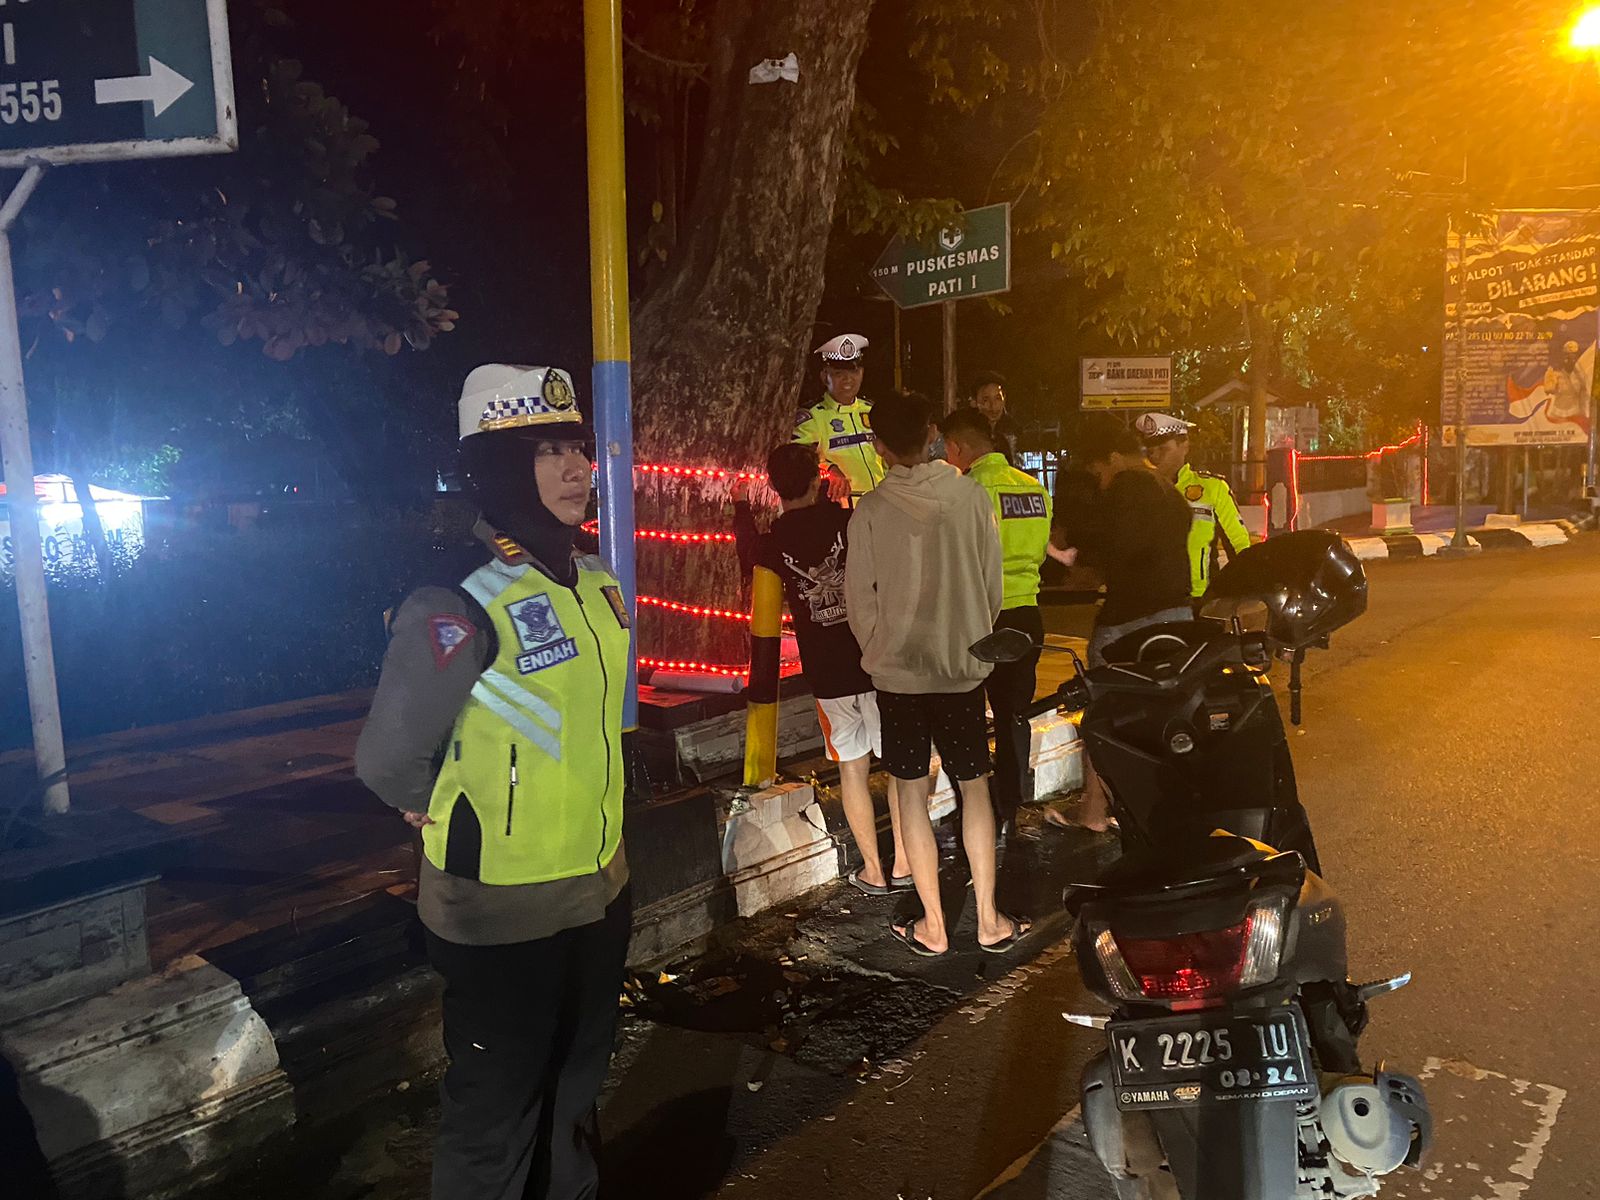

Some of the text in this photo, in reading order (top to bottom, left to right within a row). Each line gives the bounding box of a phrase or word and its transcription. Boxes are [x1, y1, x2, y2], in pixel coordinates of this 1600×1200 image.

[873, 265, 899, 277] 150 M
[906, 245, 1000, 276] PUSKESMAS
[1450, 265, 1504, 285] KALPOT
[1510, 258, 1542, 272] TIDAK
[928, 275, 977, 297] PATI I
[1487, 264, 1587, 300] DILARANG
[1106, 368, 1126, 379] BANK
[1154, 368, 1169, 379] PATI
[1002, 495, 1045, 515] POLISI
[519, 642, 574, 672] ENDAH
[1120, 1037, 1141, 1069] K
[1157, 1028, 1232, 1067] 2225
[1131, 1091, 1170, 1103] YAMAHA
[1215, 1092, 1260, 1100] SEMAKIN
[1273, 1088, 1309, 1097] DEPAN
